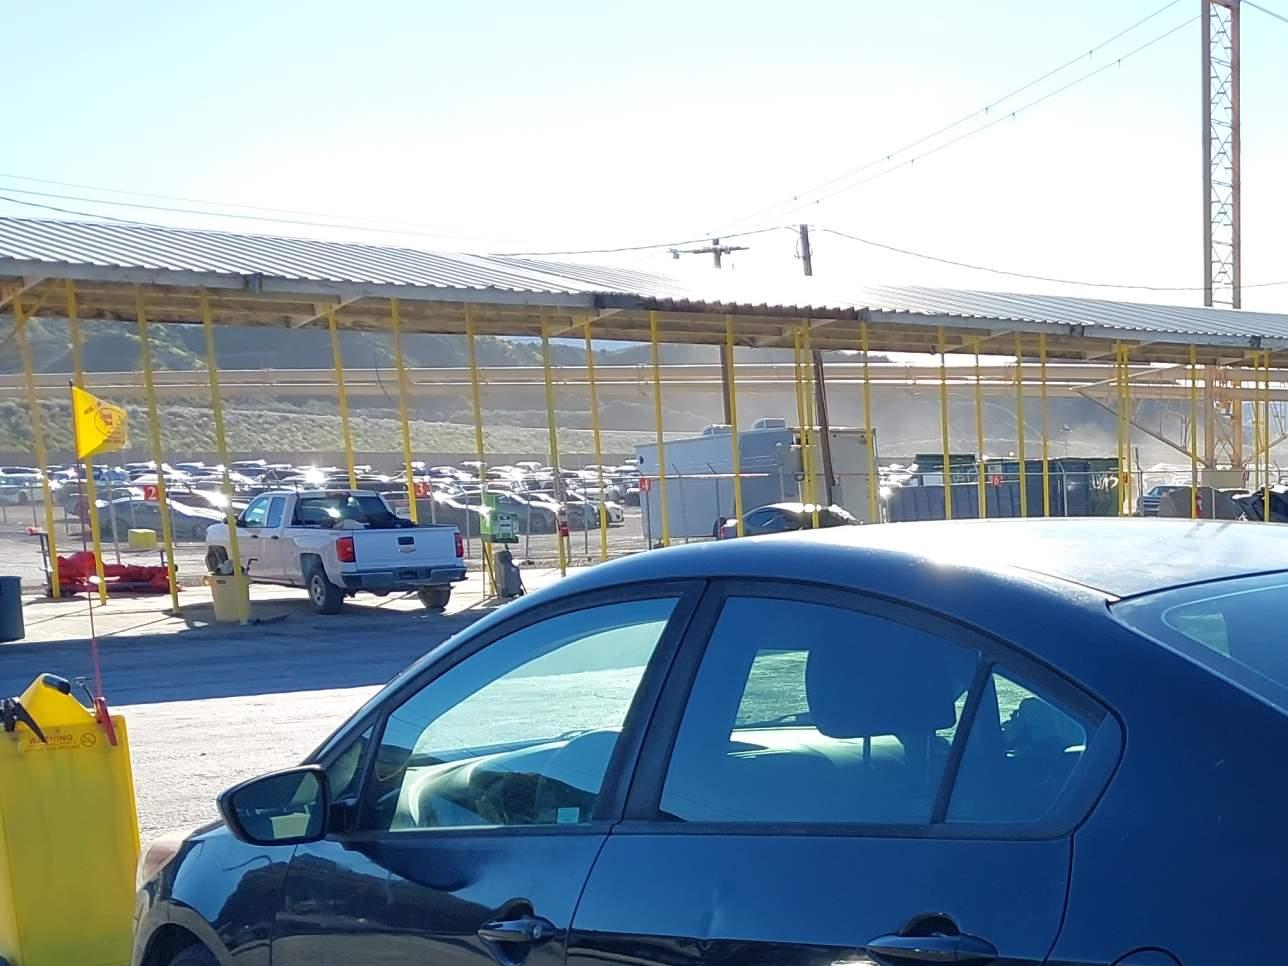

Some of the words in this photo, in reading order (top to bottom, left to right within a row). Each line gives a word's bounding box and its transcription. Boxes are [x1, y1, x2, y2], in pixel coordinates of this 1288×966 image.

[147, 486, 157, 500] 2
[415, 483, 424, 496] 3
[29, 733, 73, 745] WNING
